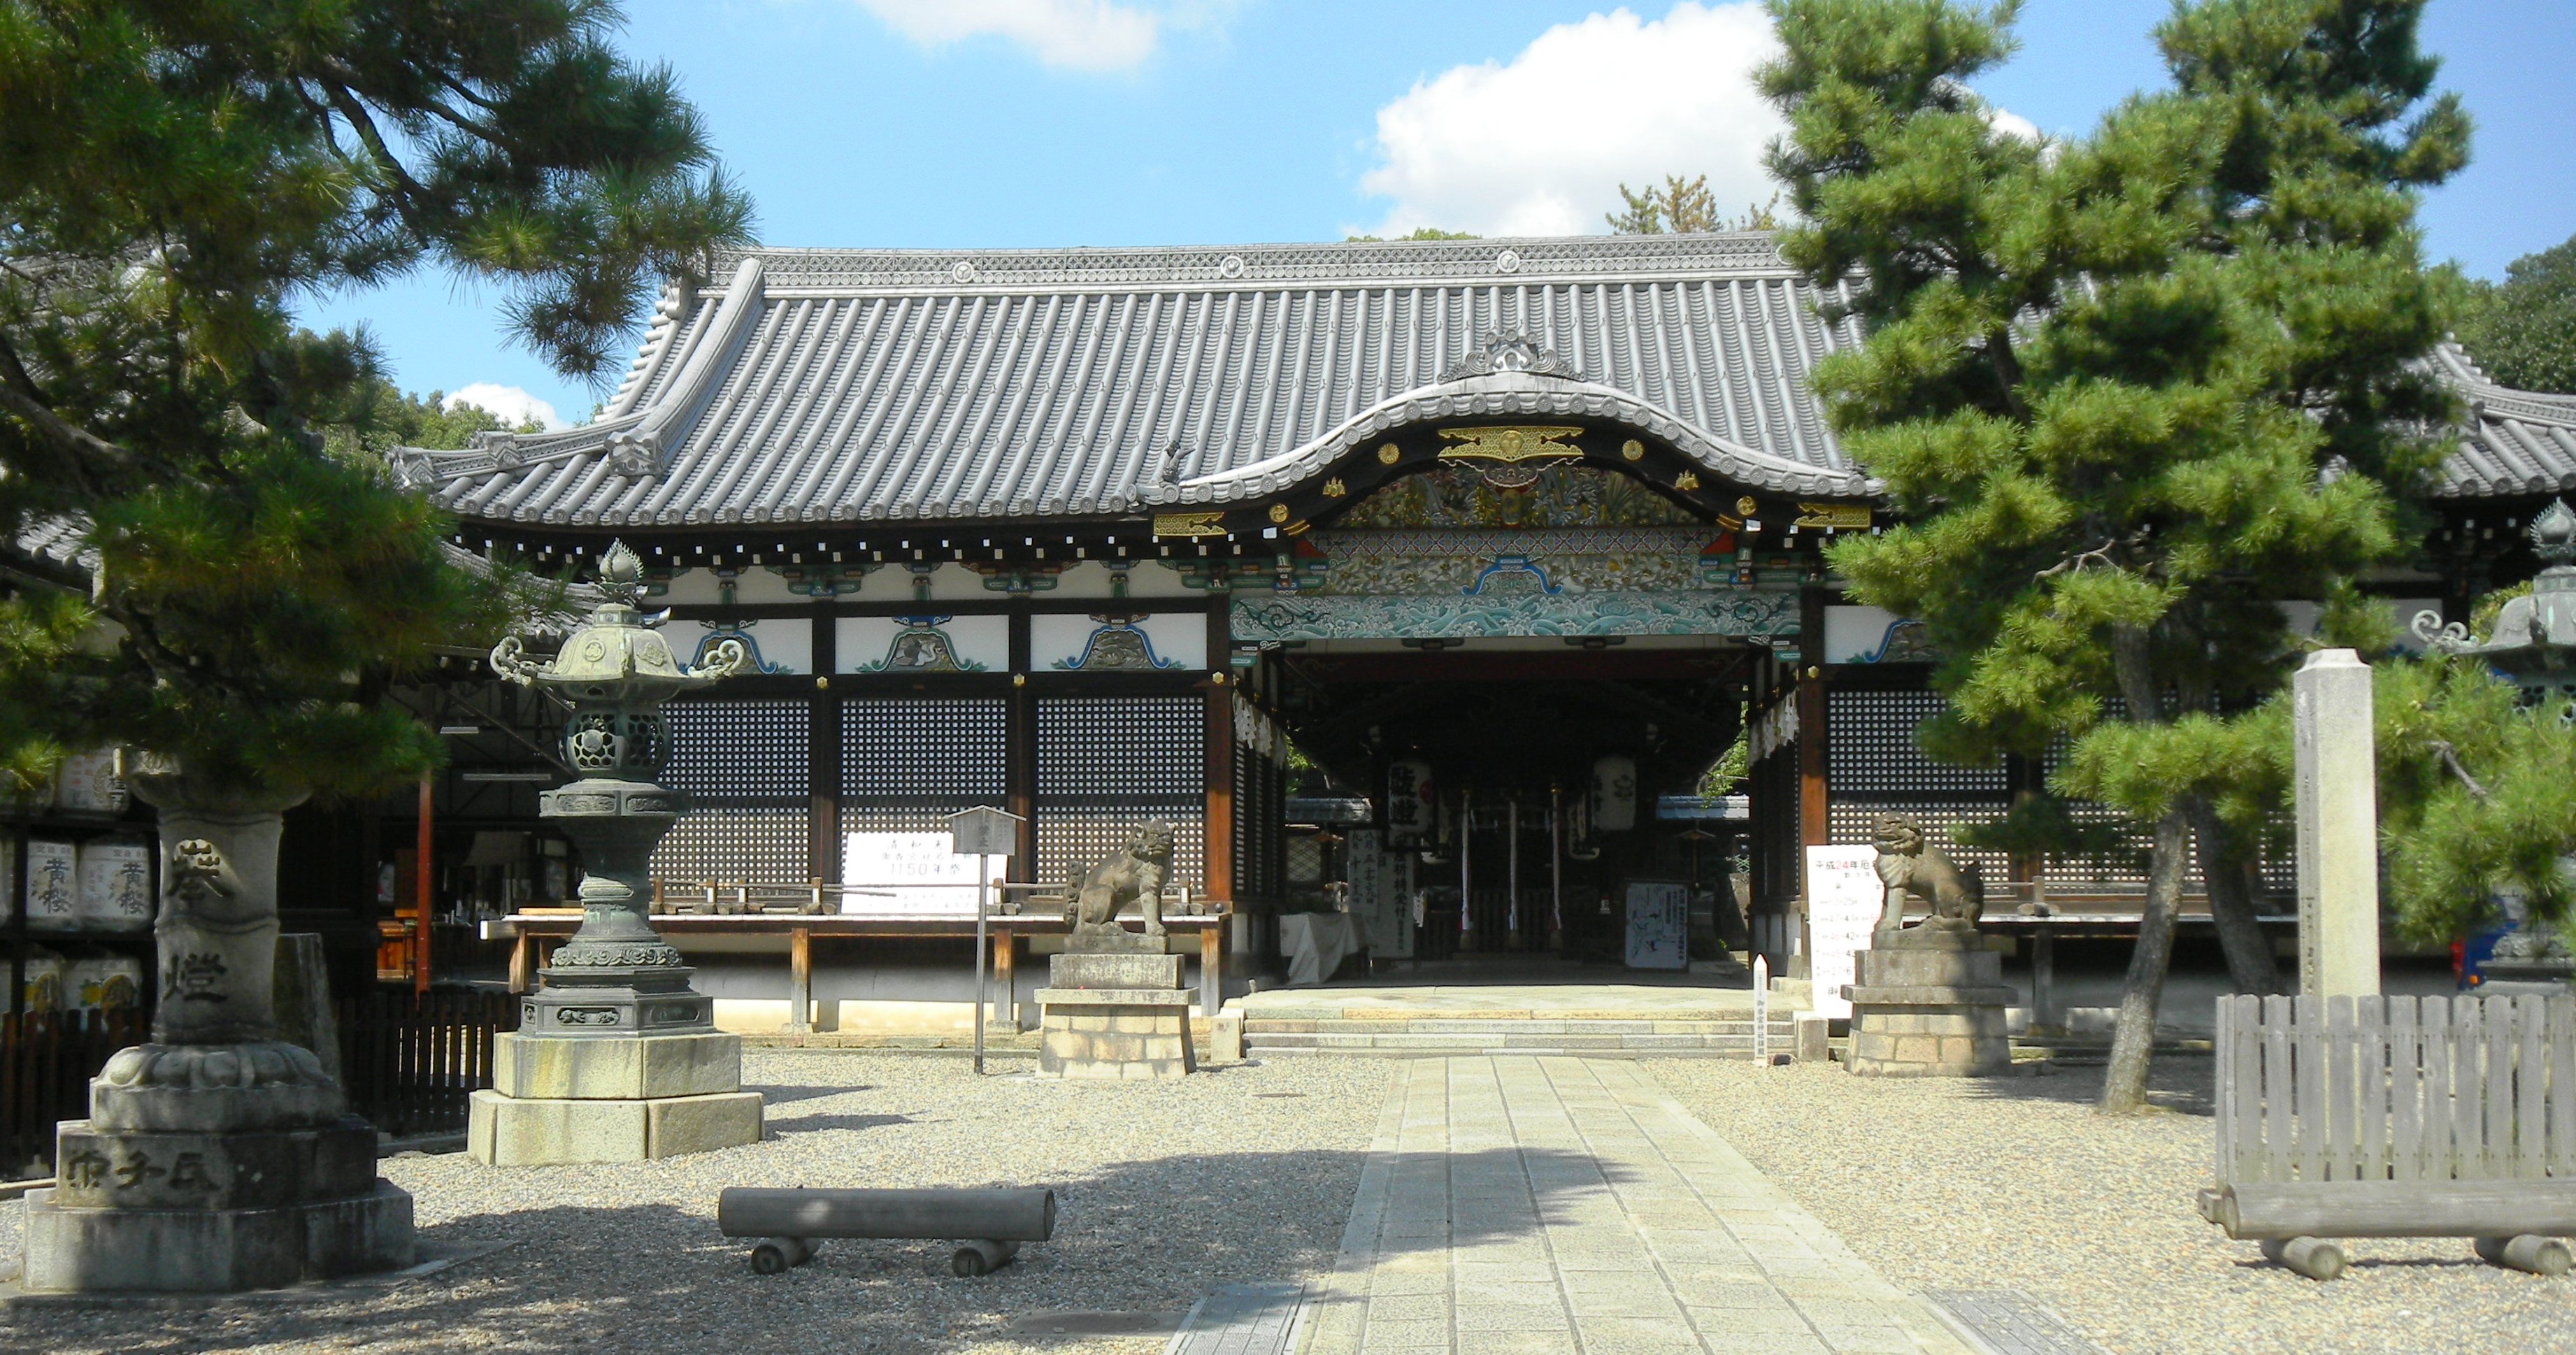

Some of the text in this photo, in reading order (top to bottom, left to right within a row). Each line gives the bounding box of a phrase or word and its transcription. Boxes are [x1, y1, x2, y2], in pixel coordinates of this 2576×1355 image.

[891, 863, 961, 876] 1150年祭
[1815, 859, 1875, 870] 平成24年厄
